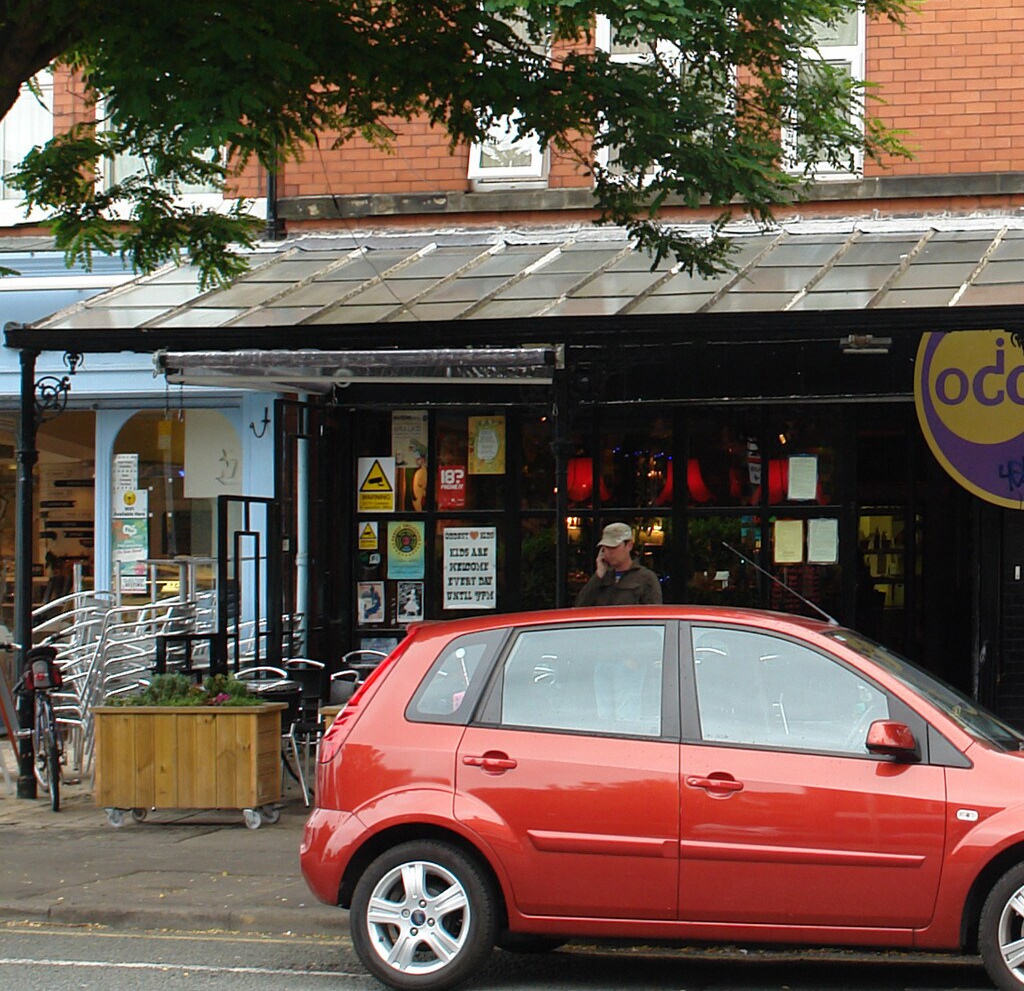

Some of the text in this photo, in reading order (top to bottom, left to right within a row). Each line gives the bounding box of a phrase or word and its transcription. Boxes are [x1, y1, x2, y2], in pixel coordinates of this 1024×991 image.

[441, 469, 464, 484] 18?
[450, 548, 488, 557] KIDS ARE
[449, 562, 489, 571] WELCOME
[448, 576, 493, 586] EVERY DAY
[446, 591, 494, 601] UNTIL 7PM
